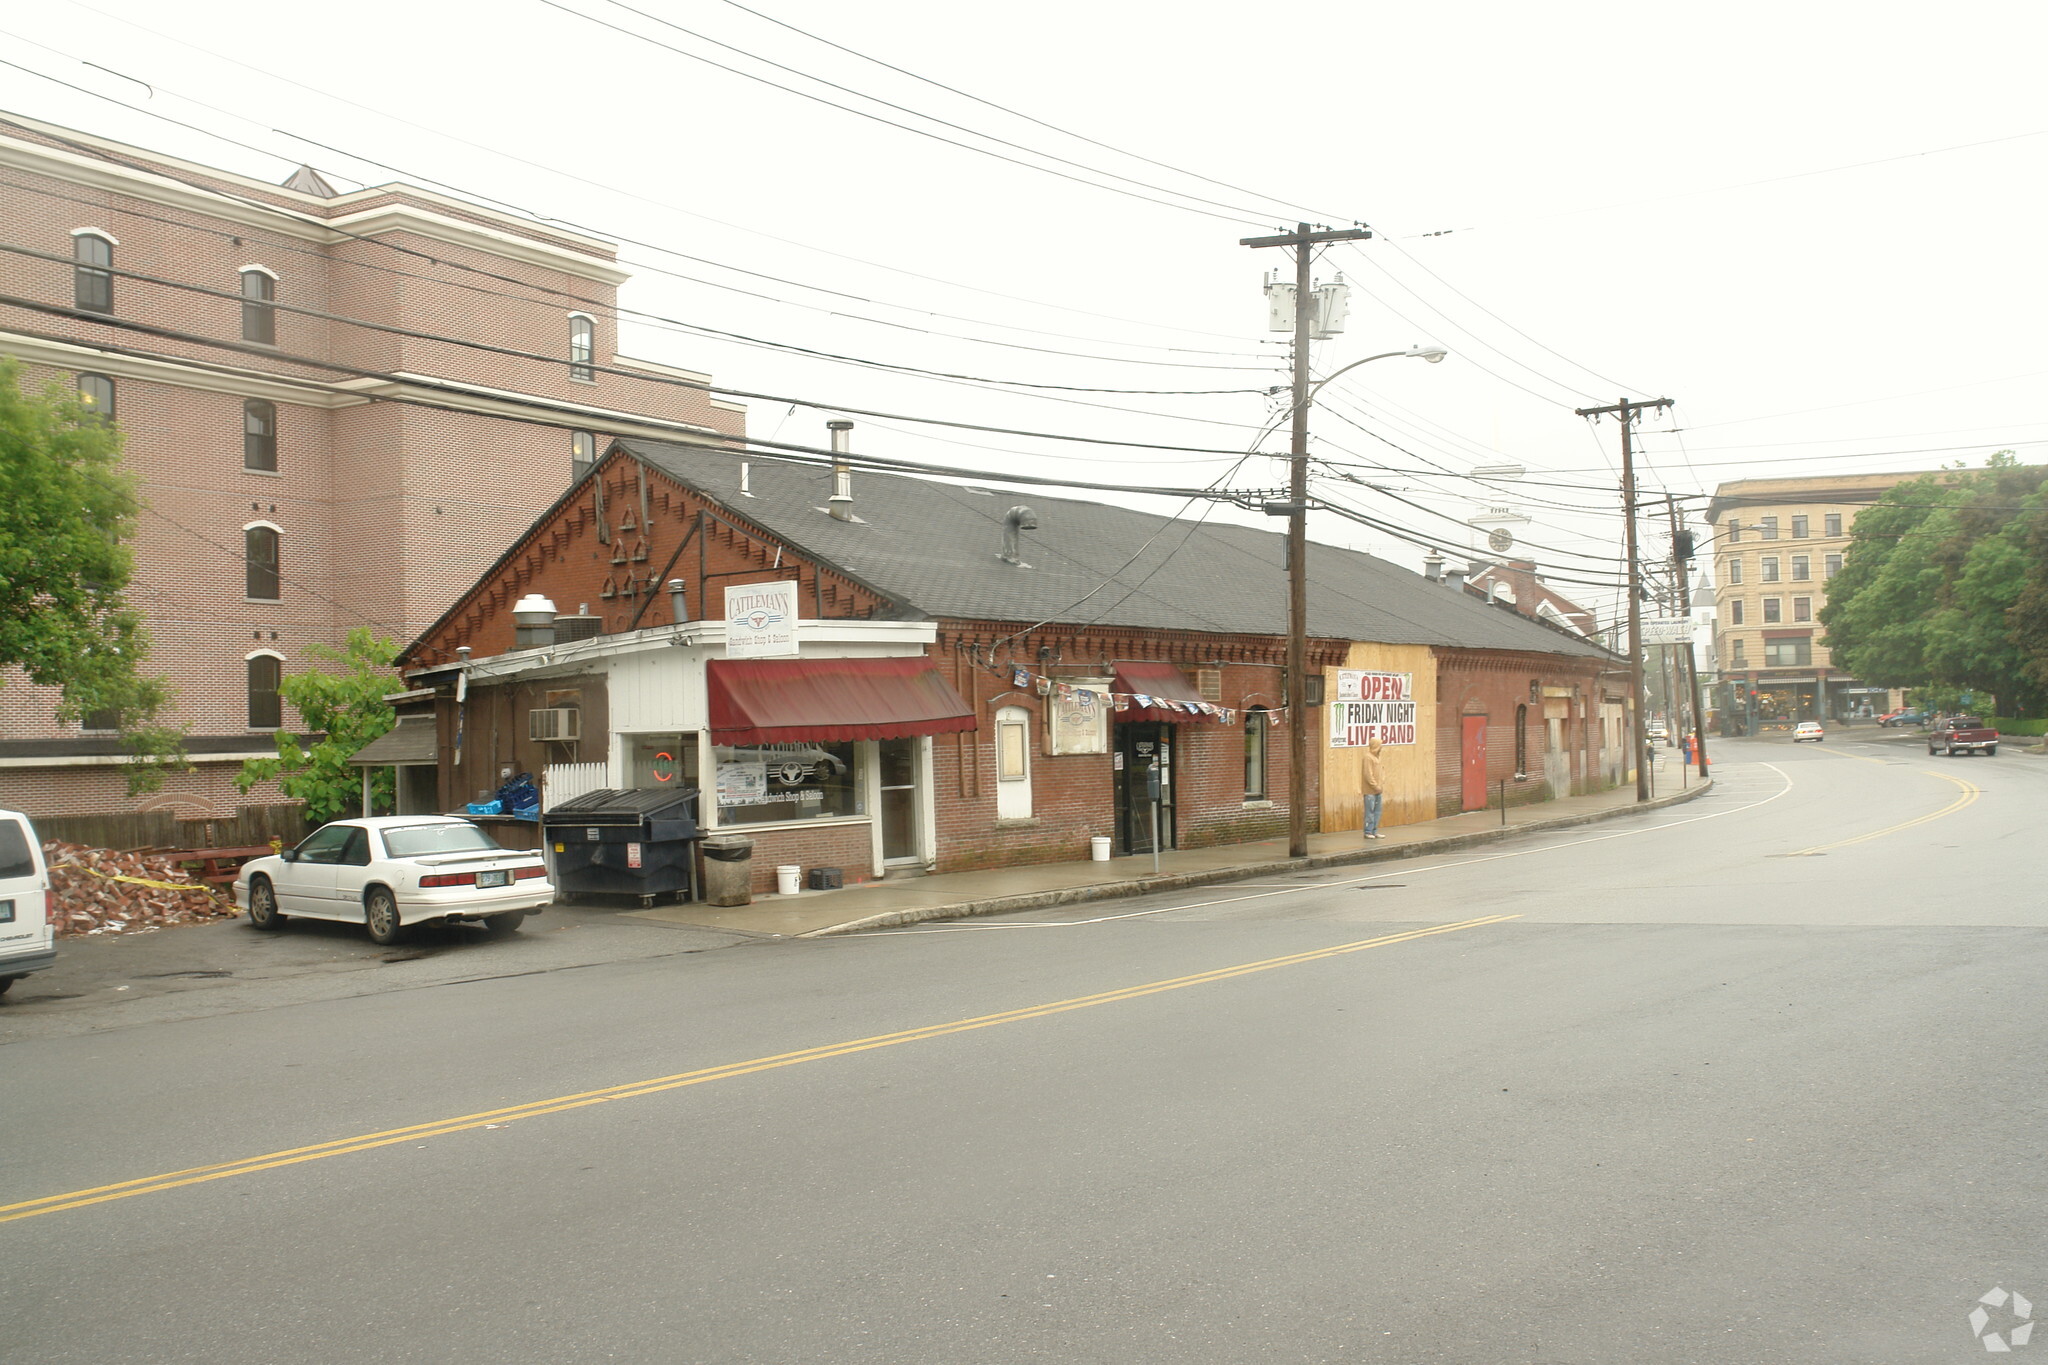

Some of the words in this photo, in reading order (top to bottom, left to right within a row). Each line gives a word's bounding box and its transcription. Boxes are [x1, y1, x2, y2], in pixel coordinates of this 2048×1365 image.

[729, 592, 789, 620] CATTLEMAN'S
[729, 636, 753, 647] Sandwich
[754, 634, 767, 646] Shop
[773, 633, 790, 644] Saloon
[1361, 676, 1403, 700] OPEN
[1347, 703, 1384, 723] FRIDAY
[1386, 703, 1415, 722] NIGHT
[1347, 725, 1376, 745] LIVE
[1380, 725, 1414, 744] BAND
[785, 790, 799, 803] Shop
[800, 790, 805, 800] &
[806, 790, 823, 800] Saloon
